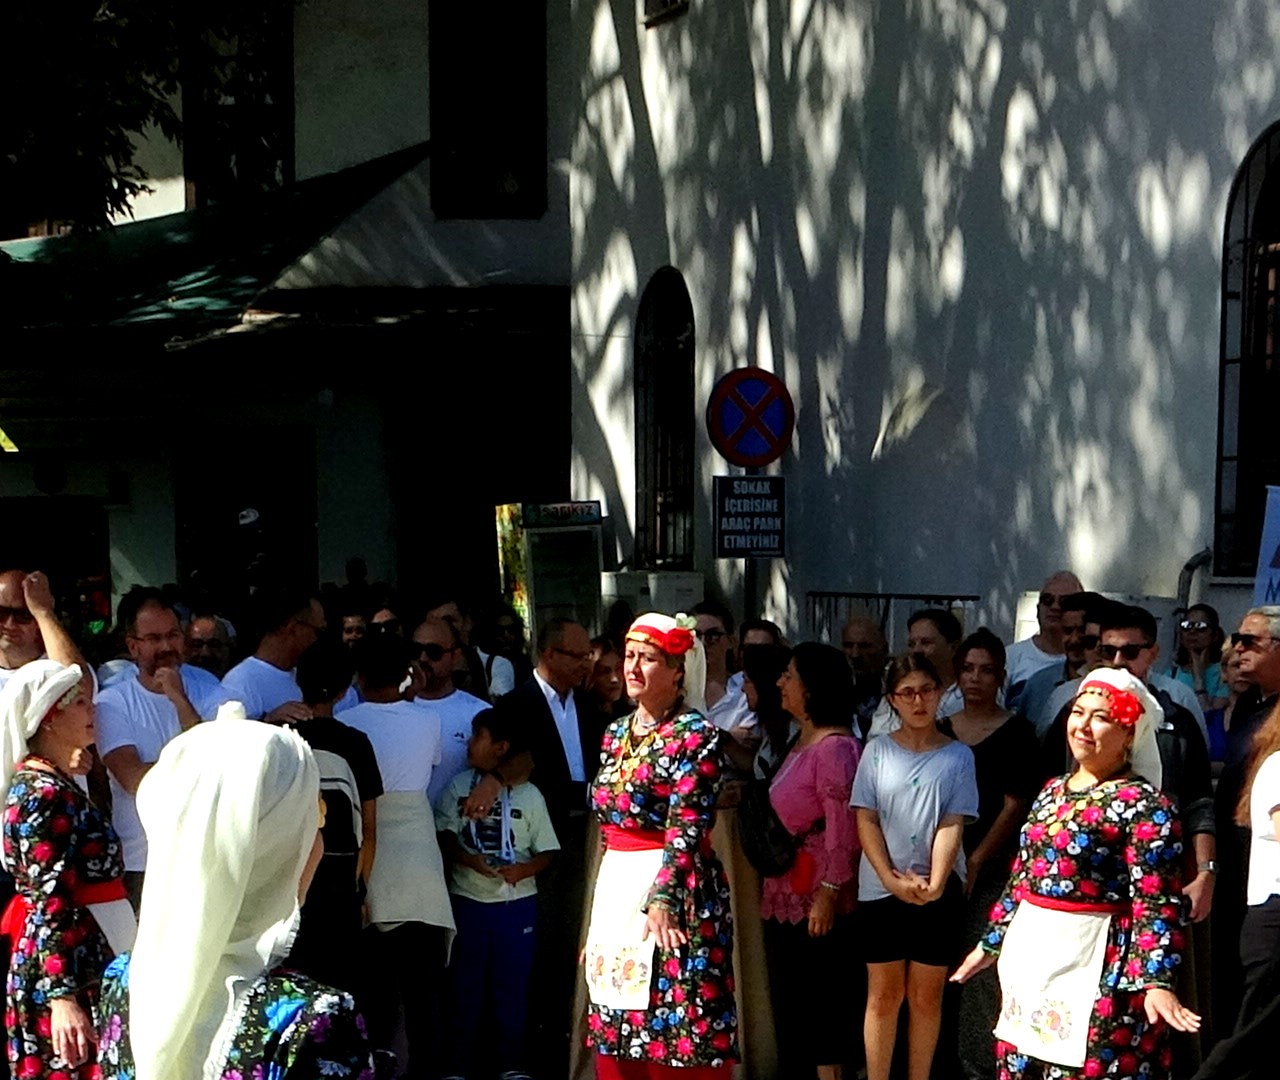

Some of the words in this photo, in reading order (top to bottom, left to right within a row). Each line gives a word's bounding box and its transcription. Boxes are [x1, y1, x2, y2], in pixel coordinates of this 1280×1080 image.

[733, 481, 770, 494] SOKAK
[725, 497, 778, 514] İÇERİSİNE
[721, 517, 751, 532] ARAÇ
[753, 517, 782, 530] PARK
[724, 533, 779, 548] ETMEYİNİZ
